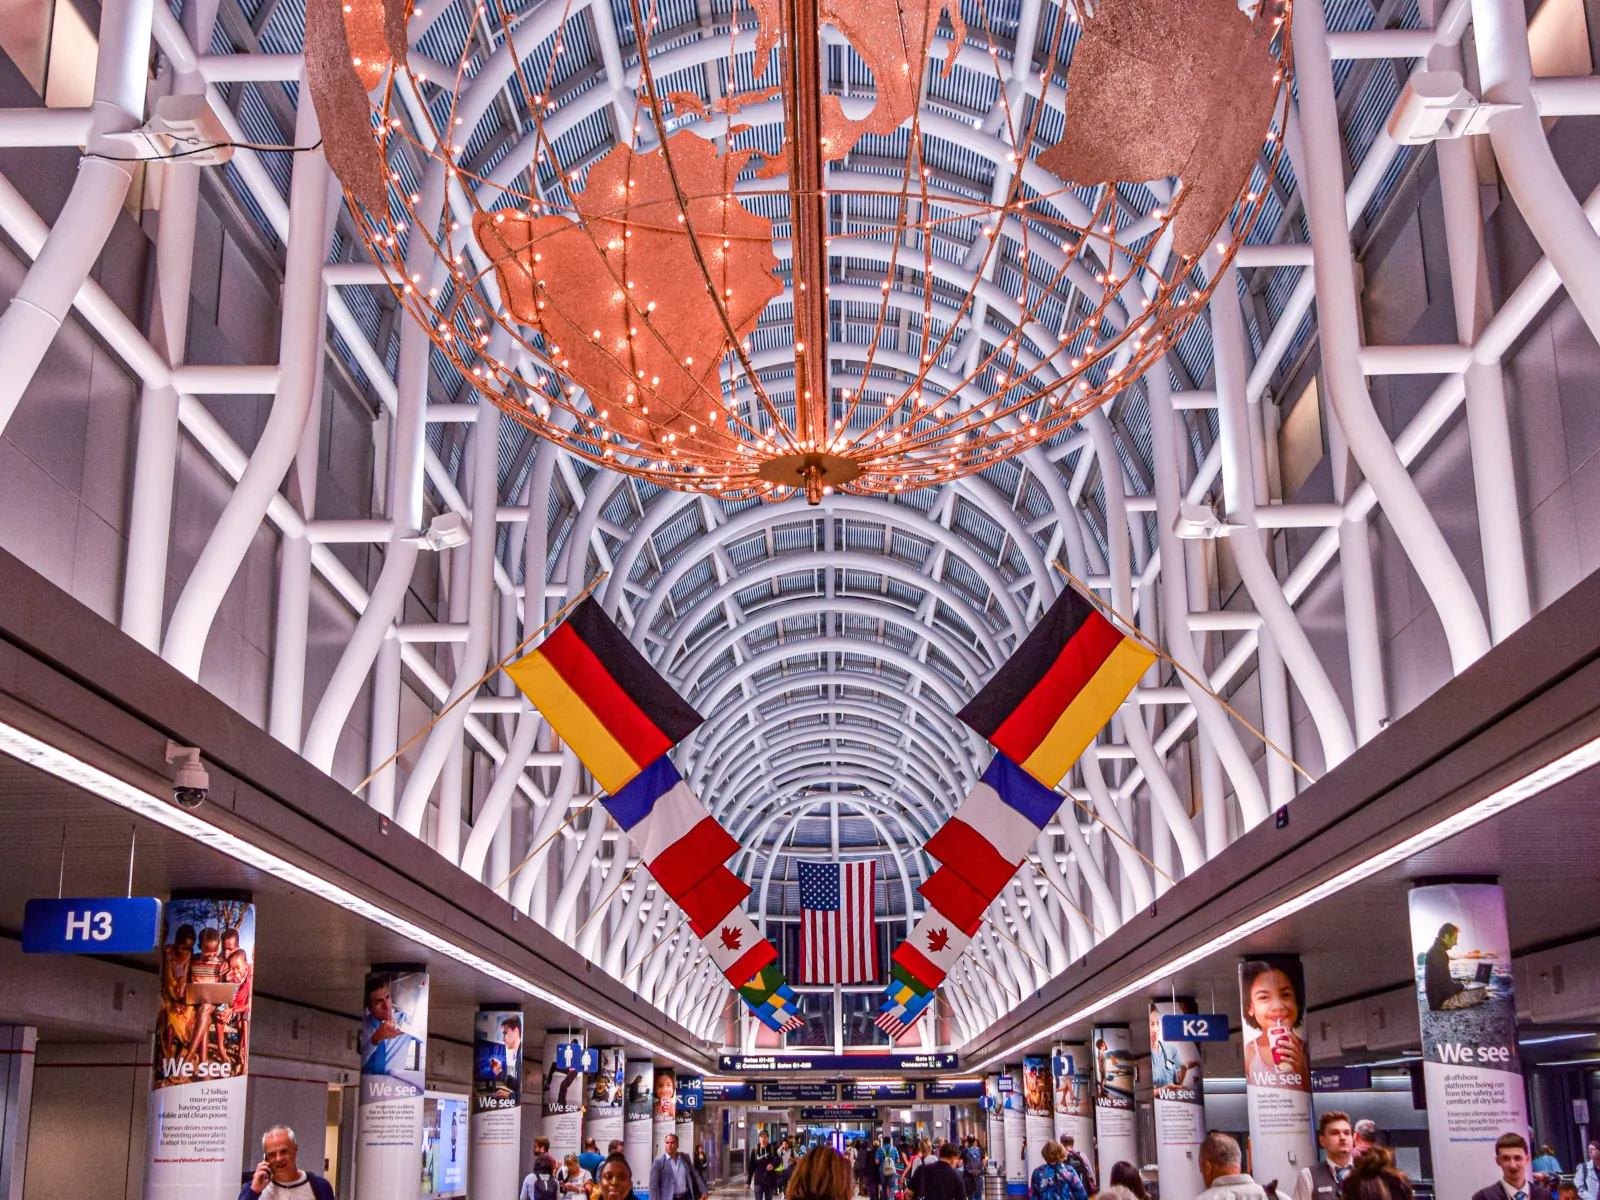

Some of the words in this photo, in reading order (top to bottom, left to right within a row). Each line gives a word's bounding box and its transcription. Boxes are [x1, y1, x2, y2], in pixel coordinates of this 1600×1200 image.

[65, 912, 113, 941] H3
[1183, 1020, 1209, 1036] K2
[1437, 1043, 1473, 1063] We
[1477, 1046, 1509, 1062] see
[162, 1058, 194, 1077] We
[198, 1062, 231, 1077] see
[1253, 1072, 1276, 1085] We
[1280, 1073, 1301, 1084] see
[369, 1083, 392, 1096] We
[395, 1086, 416, 1096] see
[1445, 1083, 1474, 1091] platforms
[1159, 1089, 1175, 1099] We
[1177, 1090, 1195, 1099] see
[208, 1096, 228, 1104] people
[479, 1097, 497, 1108] We
[499, 1099, 515, 1108] see
[687, 1097, 695, 1105] G
[1098, 1098, 1111, 1106] We
[179, 1104, 200, 1112] having
[549, 1103, 563, 1112] We
